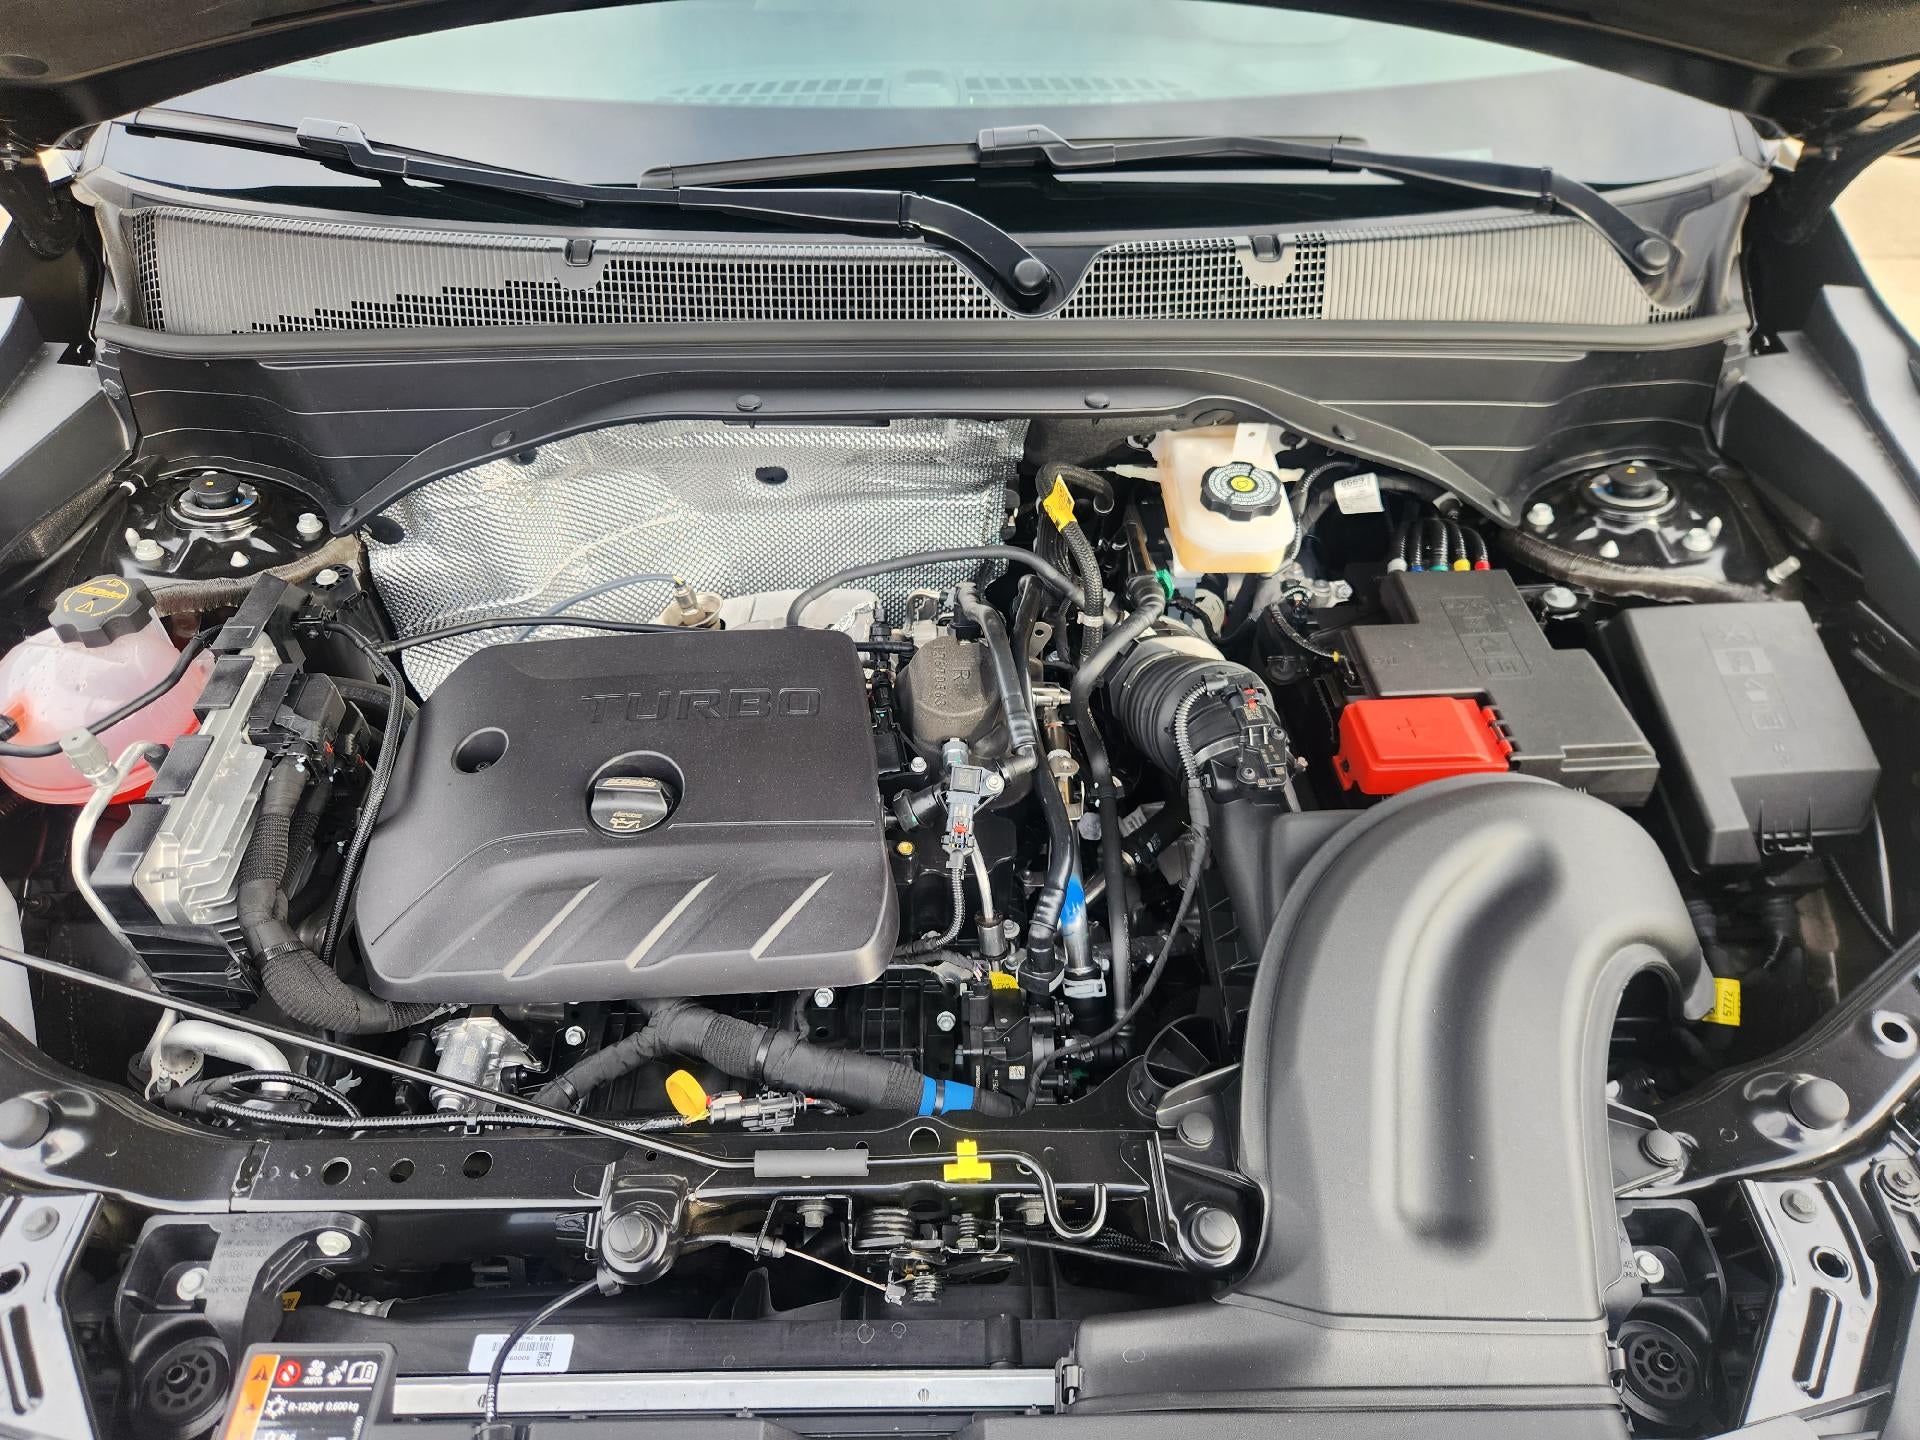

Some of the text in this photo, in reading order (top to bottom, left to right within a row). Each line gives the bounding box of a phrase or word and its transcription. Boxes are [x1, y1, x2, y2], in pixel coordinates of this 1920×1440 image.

[581, 687, 823, 724] TURBO
[303, 1376, 324, 1385] AUTO
[287, 1401, 324, 1414] R-1234yf
